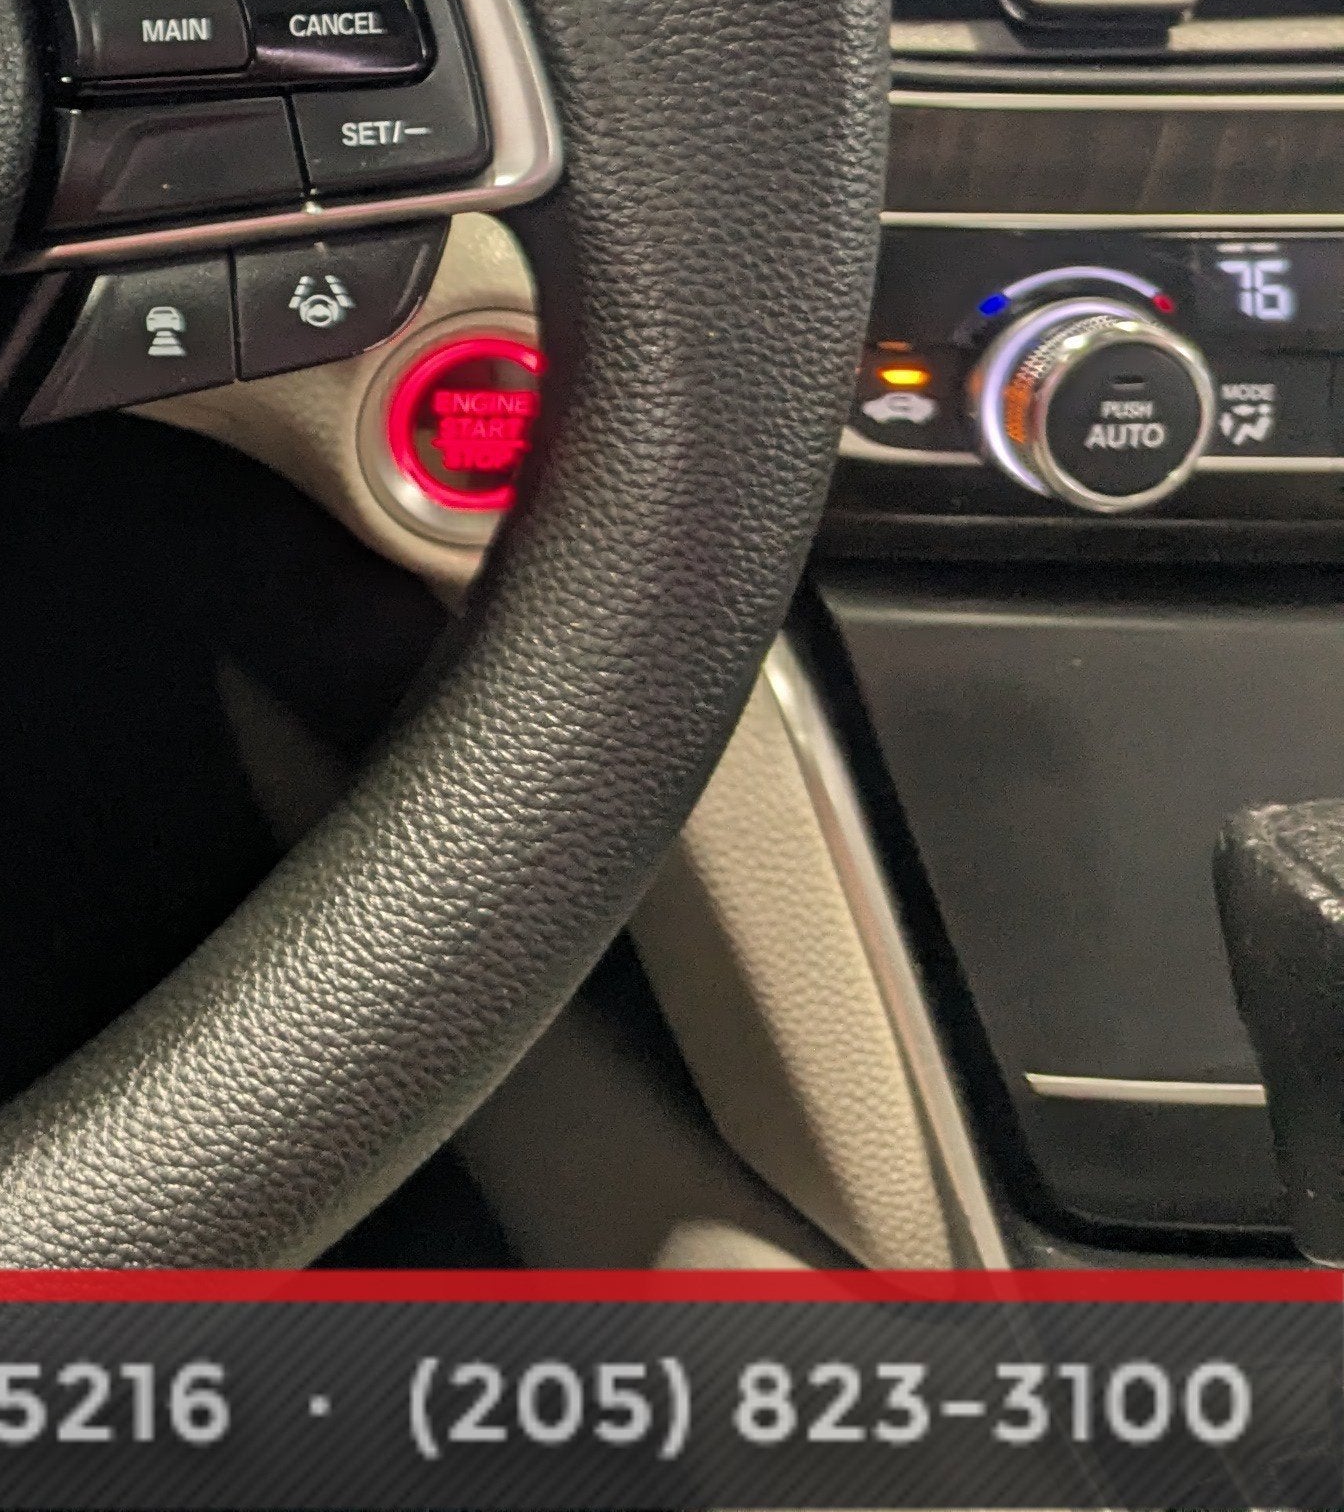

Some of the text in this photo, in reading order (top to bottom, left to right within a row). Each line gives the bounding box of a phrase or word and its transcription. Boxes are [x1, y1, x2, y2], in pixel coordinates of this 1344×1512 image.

[141, 17, 211, 42] MAIN
[289, 11, 382, 37] CANCEL
[1217, 259, 1293, 321] 76
[435, 392, 537, 416] ENGINE
[1221, 383, 1275, 401] MODE
[1099, 399, 1153, 420] PUSH
[441, 417, 525, 439] START
[1084, 422, 1166, 449] AUTO
